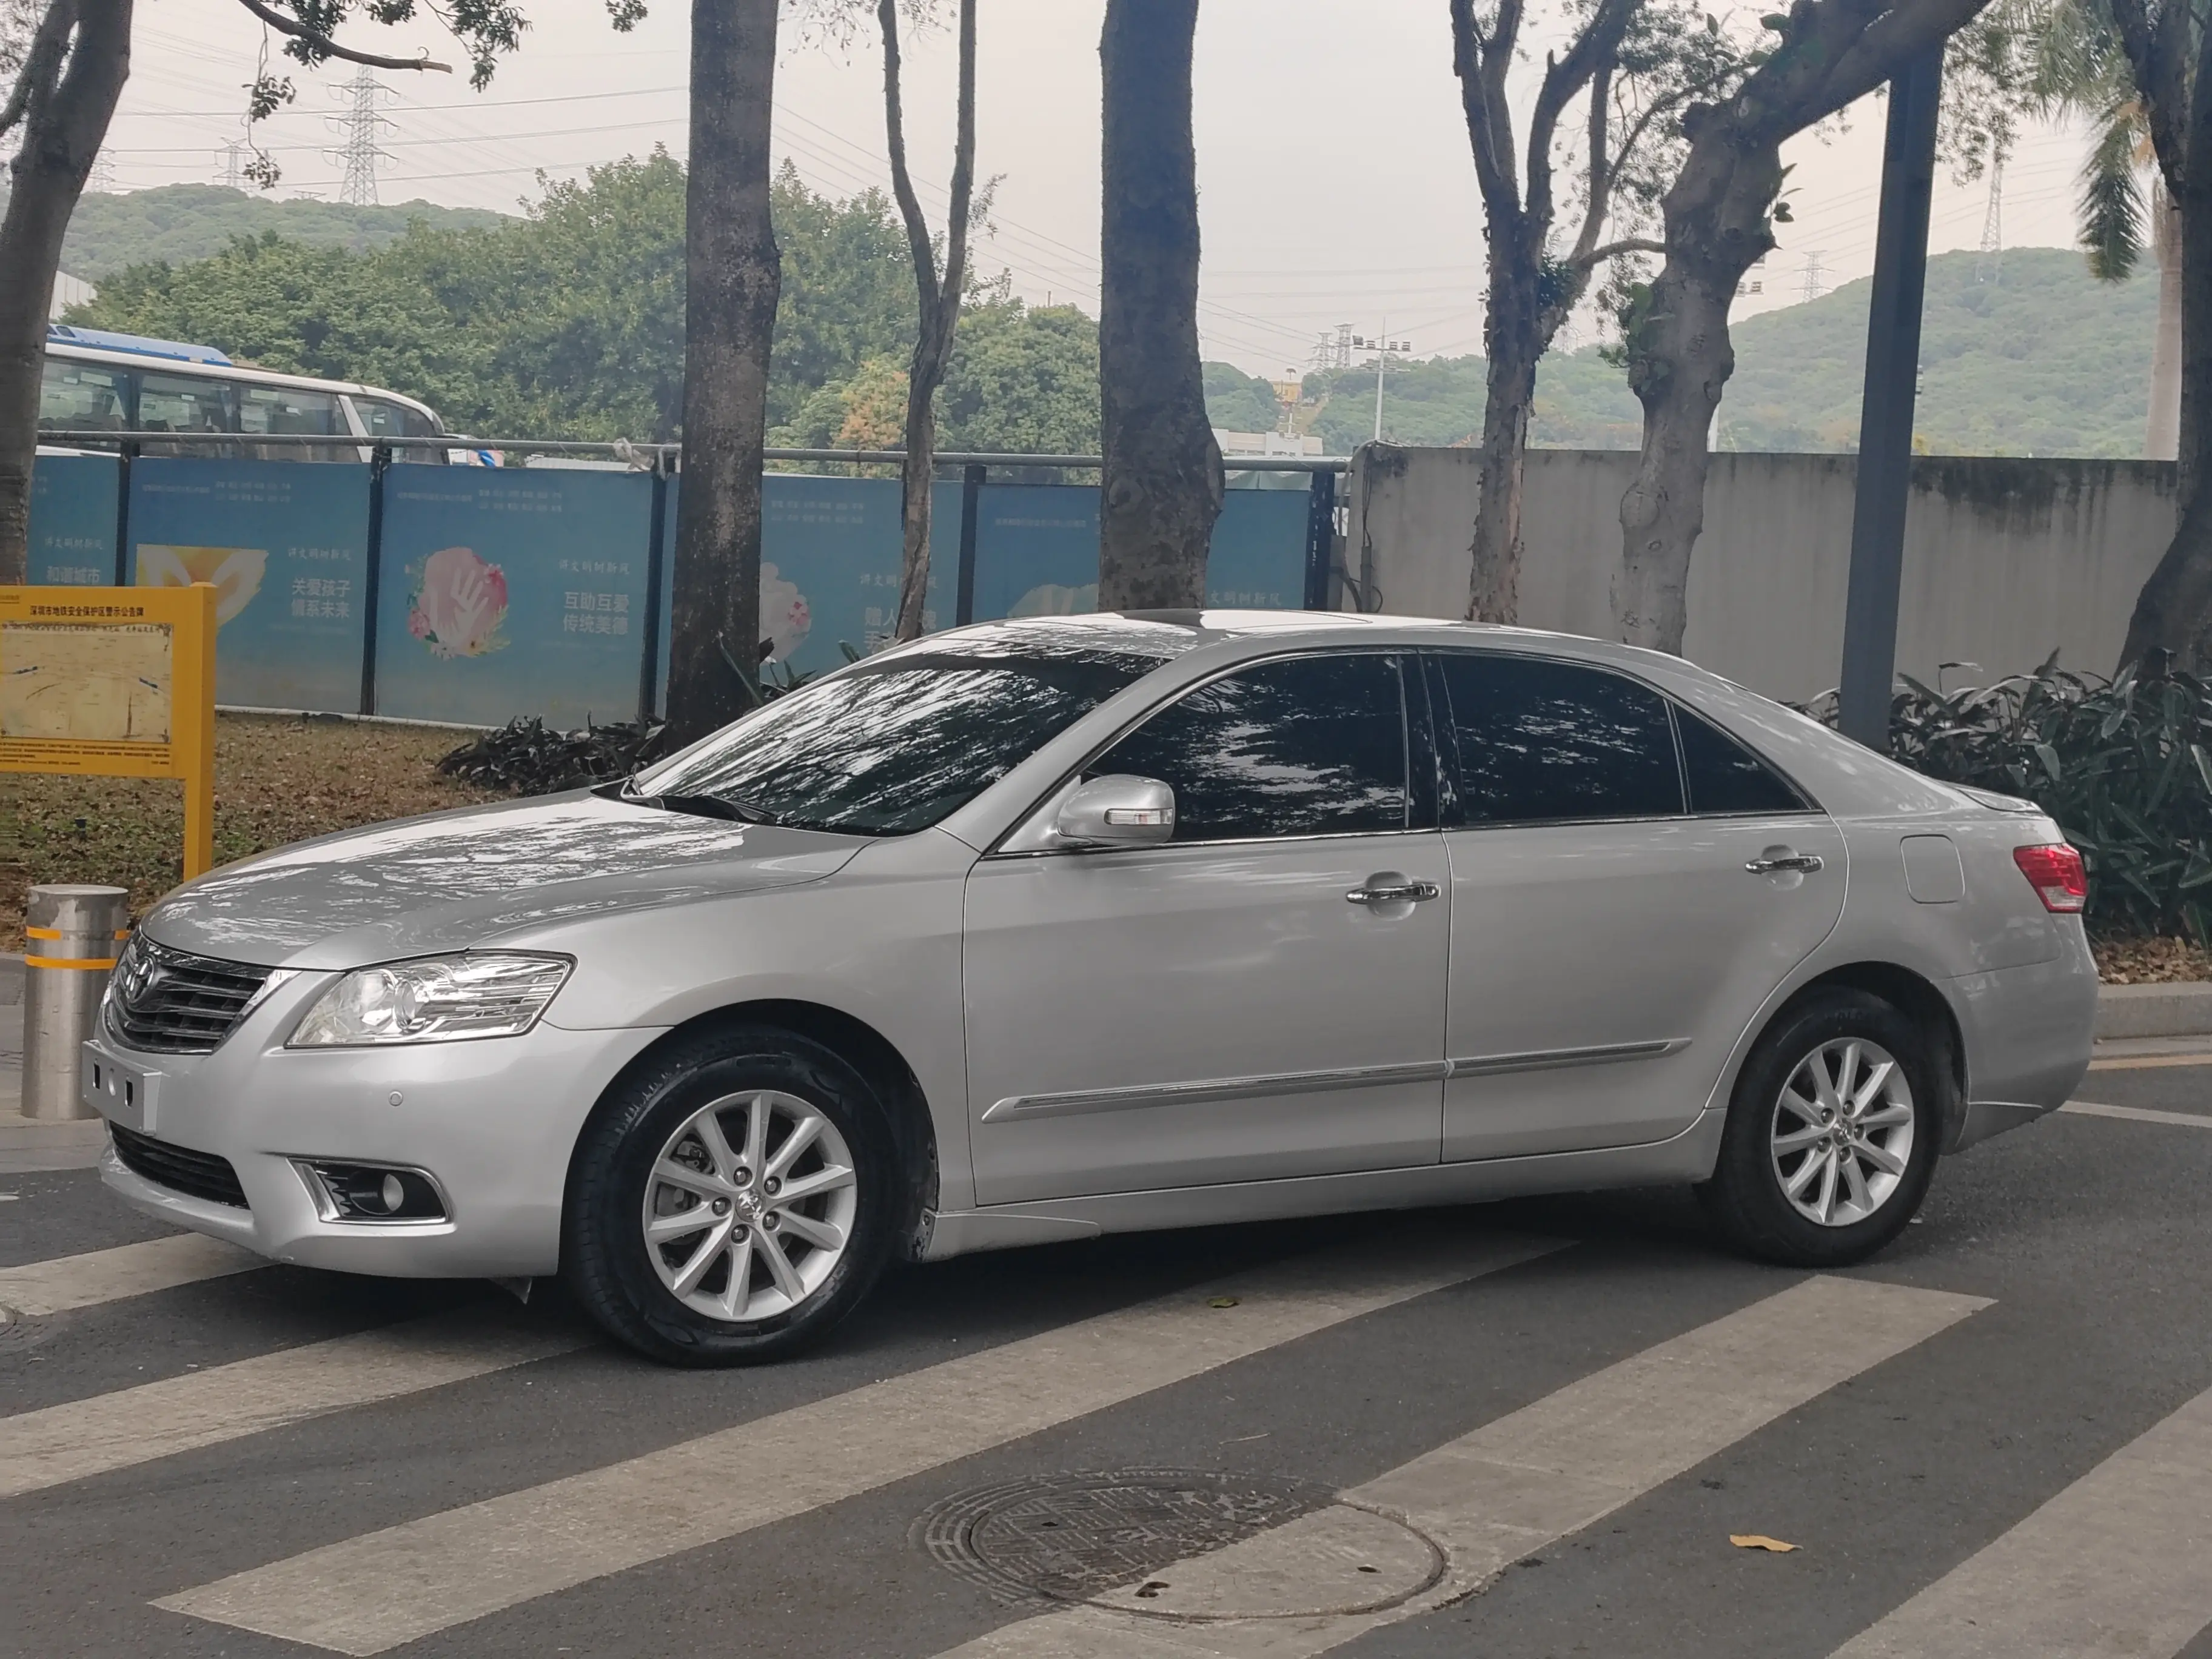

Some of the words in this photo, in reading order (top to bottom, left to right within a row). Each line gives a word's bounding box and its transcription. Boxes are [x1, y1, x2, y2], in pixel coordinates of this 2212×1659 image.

[292, 577, 350, 597] 关爱孩子
[860, 572, 938, 589] 讲文明风
[563, 591, 629, 613] 互助互爱
[1210, 589, 1282, 606] 文明树新风
[563, 612, 629, 635] 传统美德
[865, 607, 937, 629] 赠人瑰
